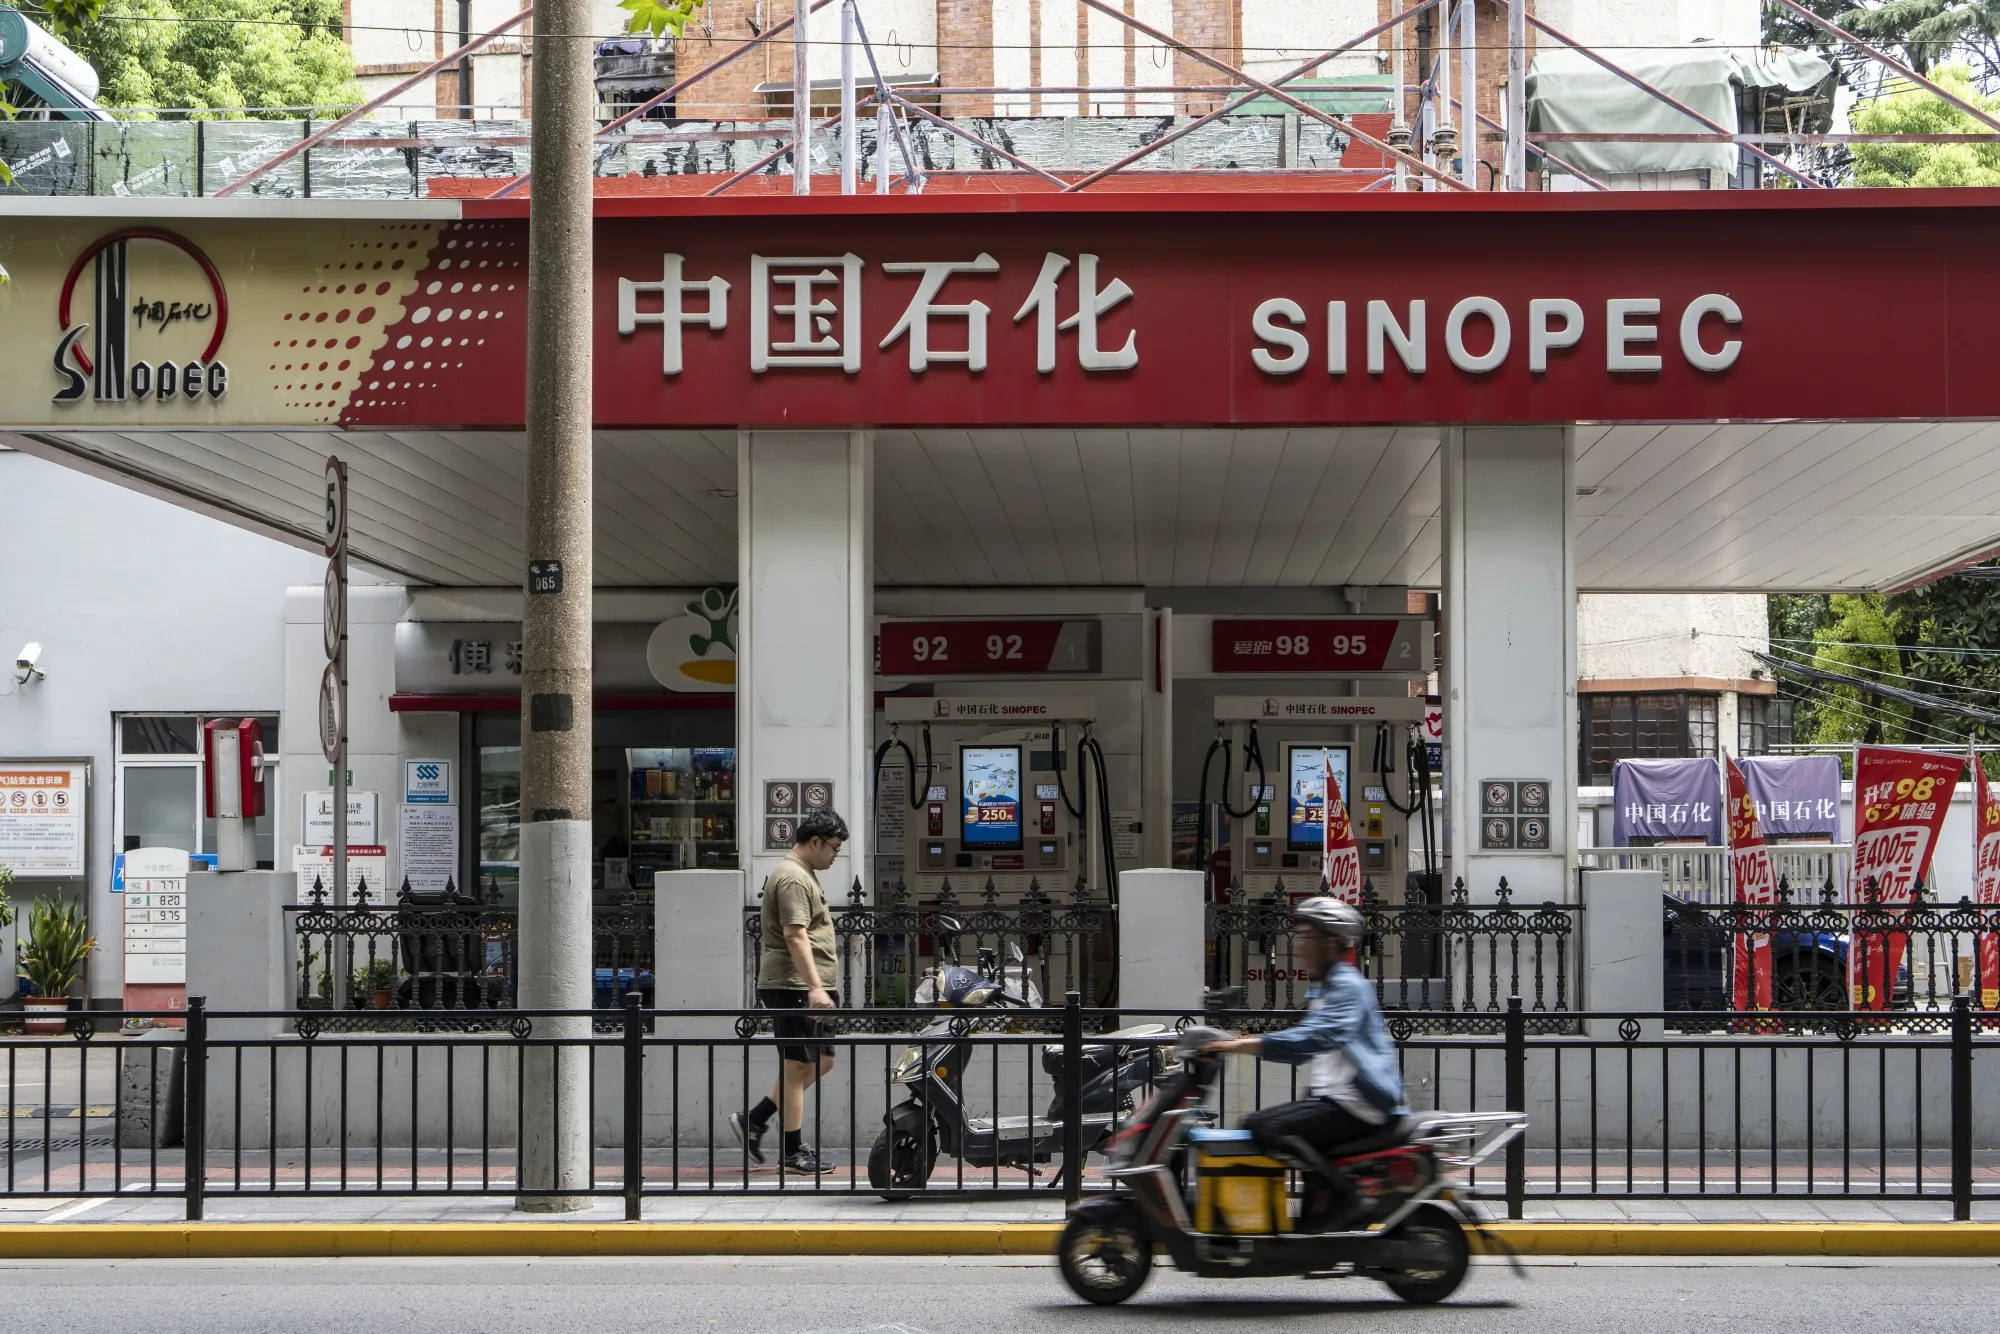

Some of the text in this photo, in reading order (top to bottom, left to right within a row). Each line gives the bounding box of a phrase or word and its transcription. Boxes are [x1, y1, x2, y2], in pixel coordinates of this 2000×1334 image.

[132, 296, 212, 332] 中国石化
[617, 252, 1139, 375] 中国石化
[1252, 293, 1743, 374] SINOPEC
[326, 482, 336, 534] 5
[536, 577, 555, 590] 065
[912, 636, 948, 661] 92
[986, 634, 1023, 660] 92
[1275, 635, 1310, 655] 98
[1332, 635, 1367, 655] 95
[957, 704, 998, 715] 中国石化
[1002, 705, 1046, 714] SINOPEC
[1286, 704, 1327, 715] 中国石化
[1331, 706, 1375, 715] SINOPEC
[57, 793, 65, 805] 5
[982, 809, 1013, 821] 250元
[1625, 801, 1712, 825] 中国石化
[1752, 798, 1837, 822] 中国石化
[1899, 802, 1936, 820] 体验
[1529, 823, 1538, 837] 5
[131, 880, 180, 891] 92 7.71
[160, 895, 180, 906] 8.20
[160, 910, 180, 921] 9.75
